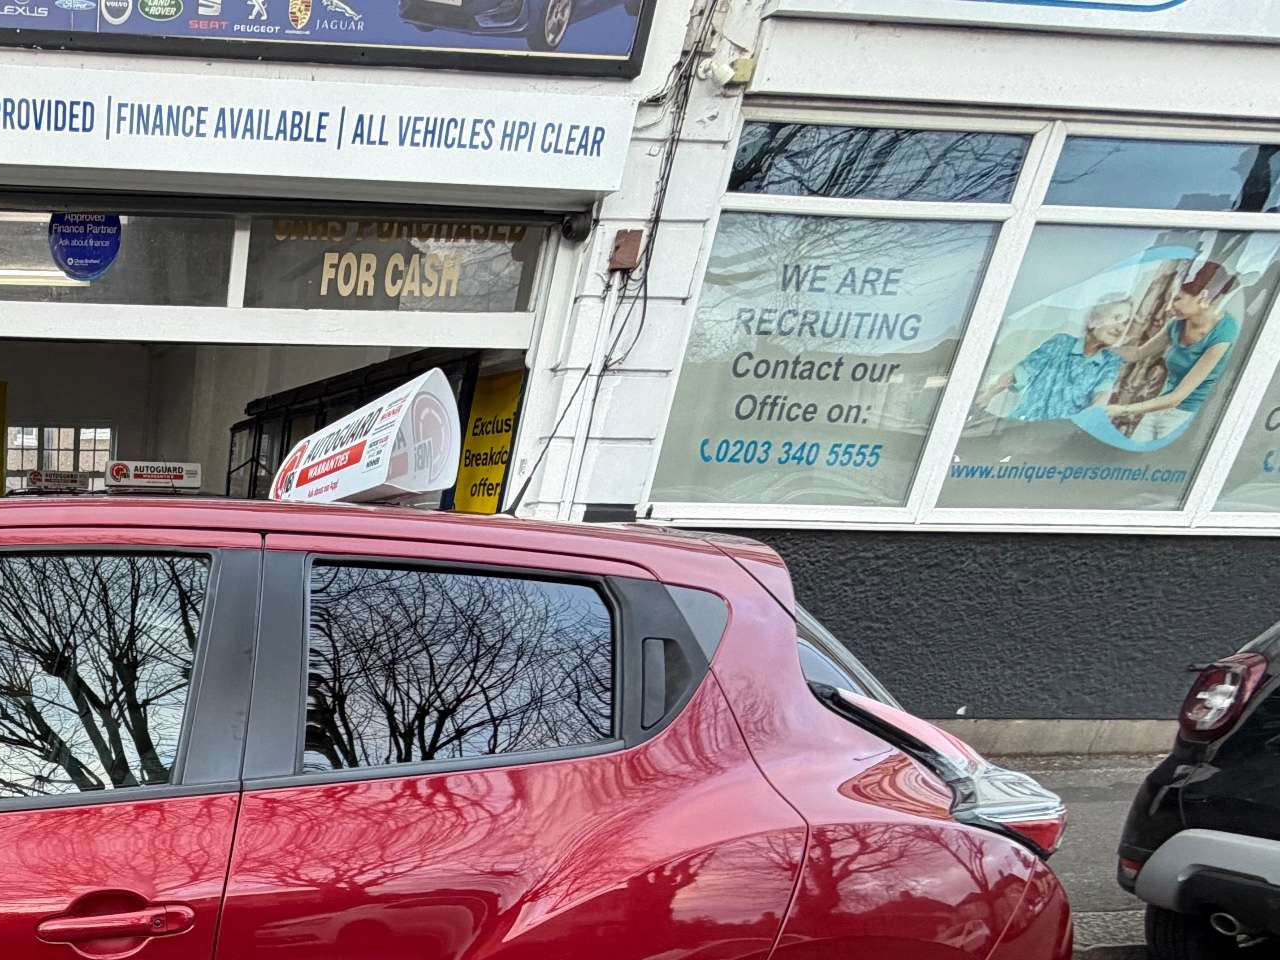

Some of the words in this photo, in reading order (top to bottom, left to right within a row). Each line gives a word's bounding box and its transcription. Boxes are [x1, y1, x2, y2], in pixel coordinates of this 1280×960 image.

[149, 6, 176, 16] ROVER
[188, 20, 229, 30] SEAT
[233, 24, 281, 34] PEUGEOT
[315, 19, 365, 32] JAGUAR
[116, 102, 209, 140] FINANCE
[213, 106, 330, 145] AVAILABLE
[352, 113, 391, 148] ALL
[397, 115, 496, 152] VEHICLES
[499, 119, 535, 154] HPI
[541, 122, 606, 158] CLEAR
[52, 223, 85, 233] Finance
[86, 223, 118, 234] Partner
[320, 252, 377, 297] FOR
[383, 252, 461, 298] CASH
[781, 263, 831, 294] WE
[837, 267, 903, 297] ARE
[734, 307, 921, 341] RECRUITING
[731, 351, 844, 383] Contact
[851, 358, 899, 383] our
[734, 394, 821, 424] Office
[826, 402, 872, 426] on:
[303, 406, 383, 465] AUTOGUARD
[471, 412, 516, 437] Exclus
[307, 451, 351, 480] WARRANTIES
[715, 439, 771, 464] 0203
[776, 442, 820, 467] 340
[826, 445, 883, 469] 5555
[133, 465, 184, 474] AUTOGUARD
[950, 463, 1187, 485] www.unique-personnel.com
[470, 477, 501, 498] offer
